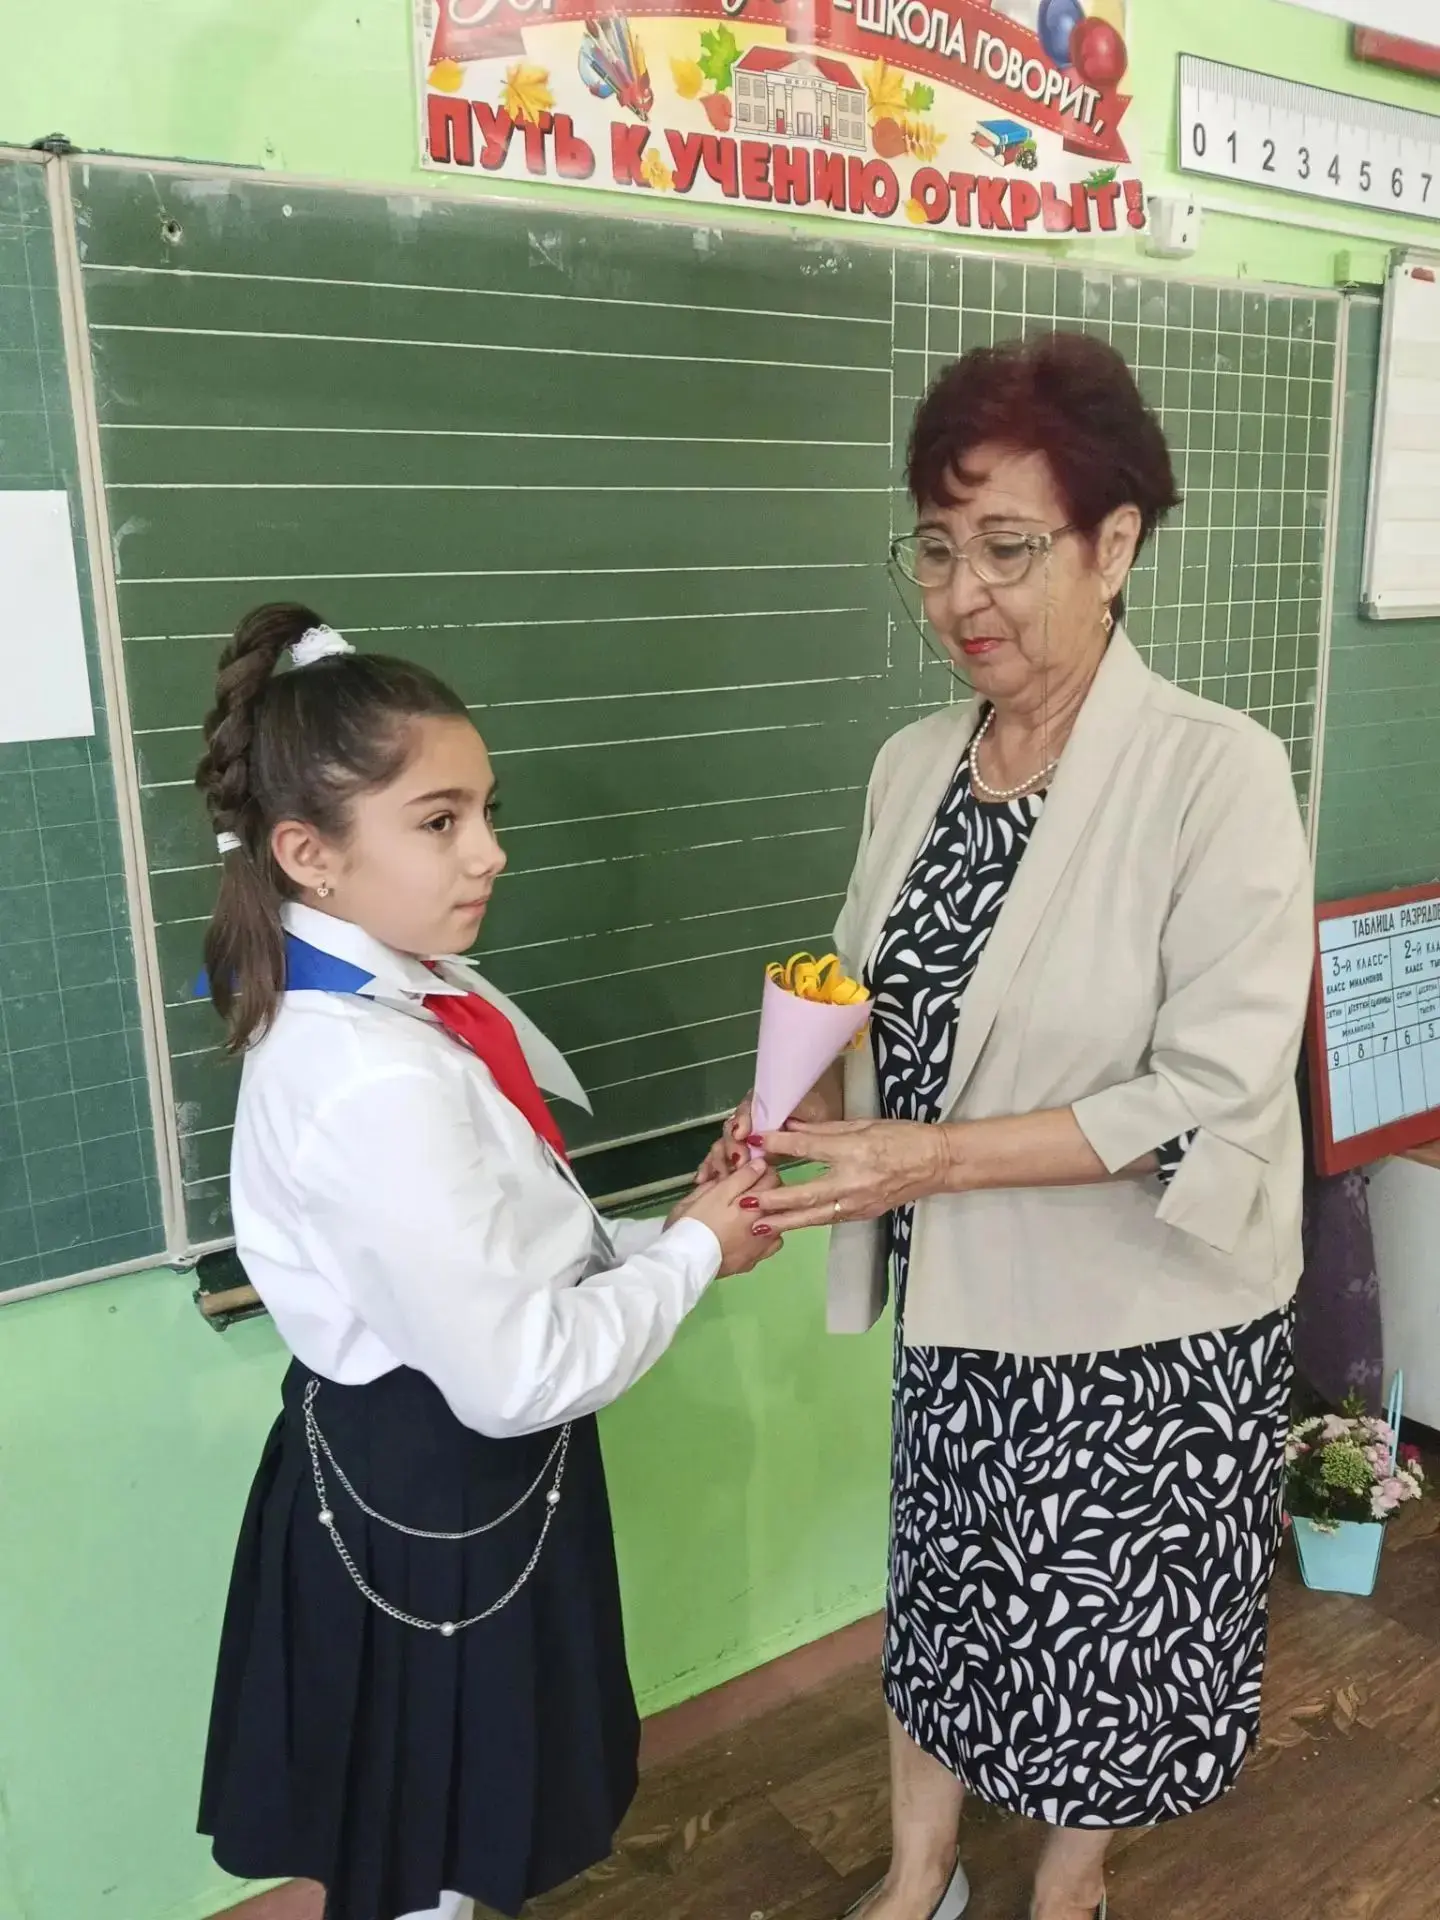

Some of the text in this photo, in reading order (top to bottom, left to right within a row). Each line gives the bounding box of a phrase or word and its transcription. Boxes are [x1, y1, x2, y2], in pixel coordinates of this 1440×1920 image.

[973, 29, 1104, 135] ГОВОРИТ,
[427, 93, 1147, 232] ПУТЬ К УЧЕНИЮ ОТКРЫТ!
[1193, 123, 1432, 202] 0 1 2 3 4 5 6 7
[1352, 912, 1395, 938] ТАБЛИЦА
[1333, 1023, 1435, 1067] 9 8 7 6 5
